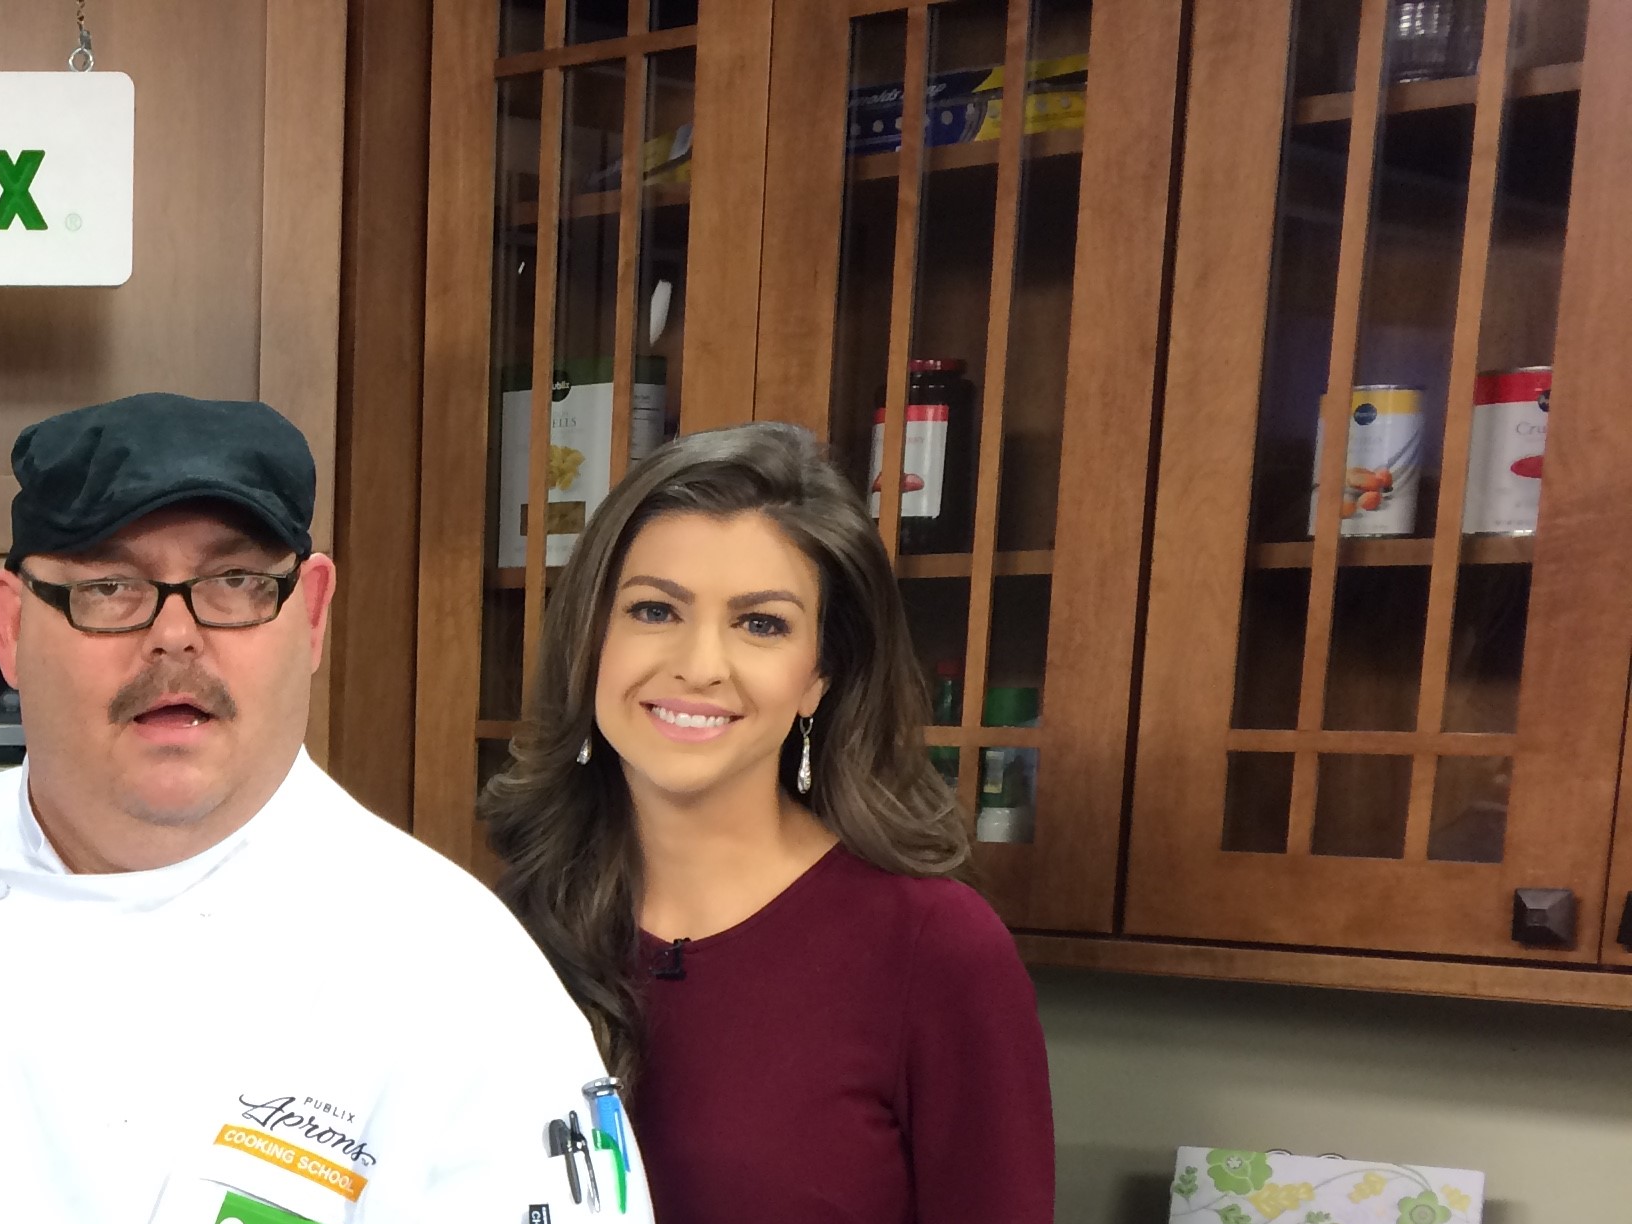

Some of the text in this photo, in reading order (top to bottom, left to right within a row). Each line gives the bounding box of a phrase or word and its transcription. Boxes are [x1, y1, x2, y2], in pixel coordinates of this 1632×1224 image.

[1516, 421, 1546, 435] Cru
[238, 1093, 376, 1166] Aprons
[303, 1096, 355, 1123] PUBLIX
[224, 1129, 355, 1194] COOKING SCHOOL
